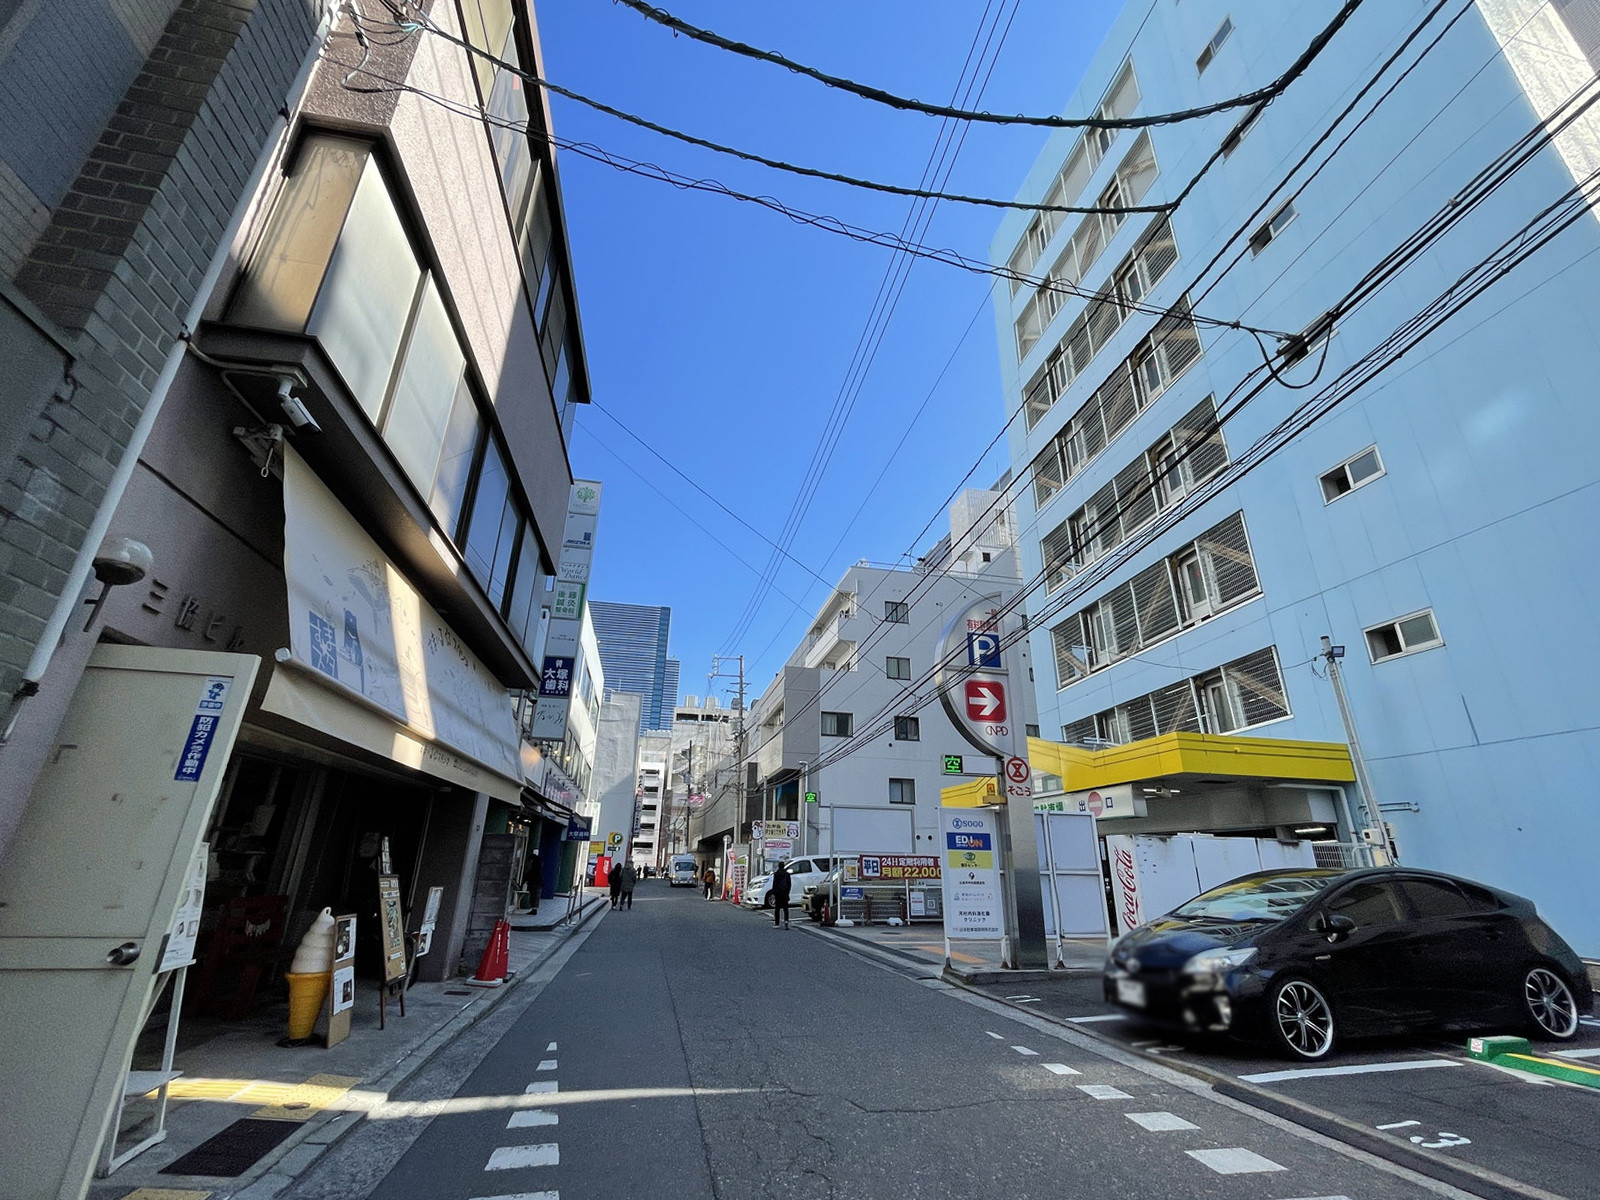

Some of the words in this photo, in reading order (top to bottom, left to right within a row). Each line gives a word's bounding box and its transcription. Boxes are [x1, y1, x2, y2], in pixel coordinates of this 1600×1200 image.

[561, 566, 583, 575] World
[564, 572, 588, 580] Dance
[972, 635, 996, 665] P
[544, 679, 570, 692] 歯科
[182, 716, 214, 774] 防犯カメラ作動中
[945, 756, 962, 773] 空
[1007, 785, 1032, 797] そこう
[962, 820, 984, 828] SOGO
[955, 835, 983, 848] EDION
[863, 859, 880, 874] 平日
